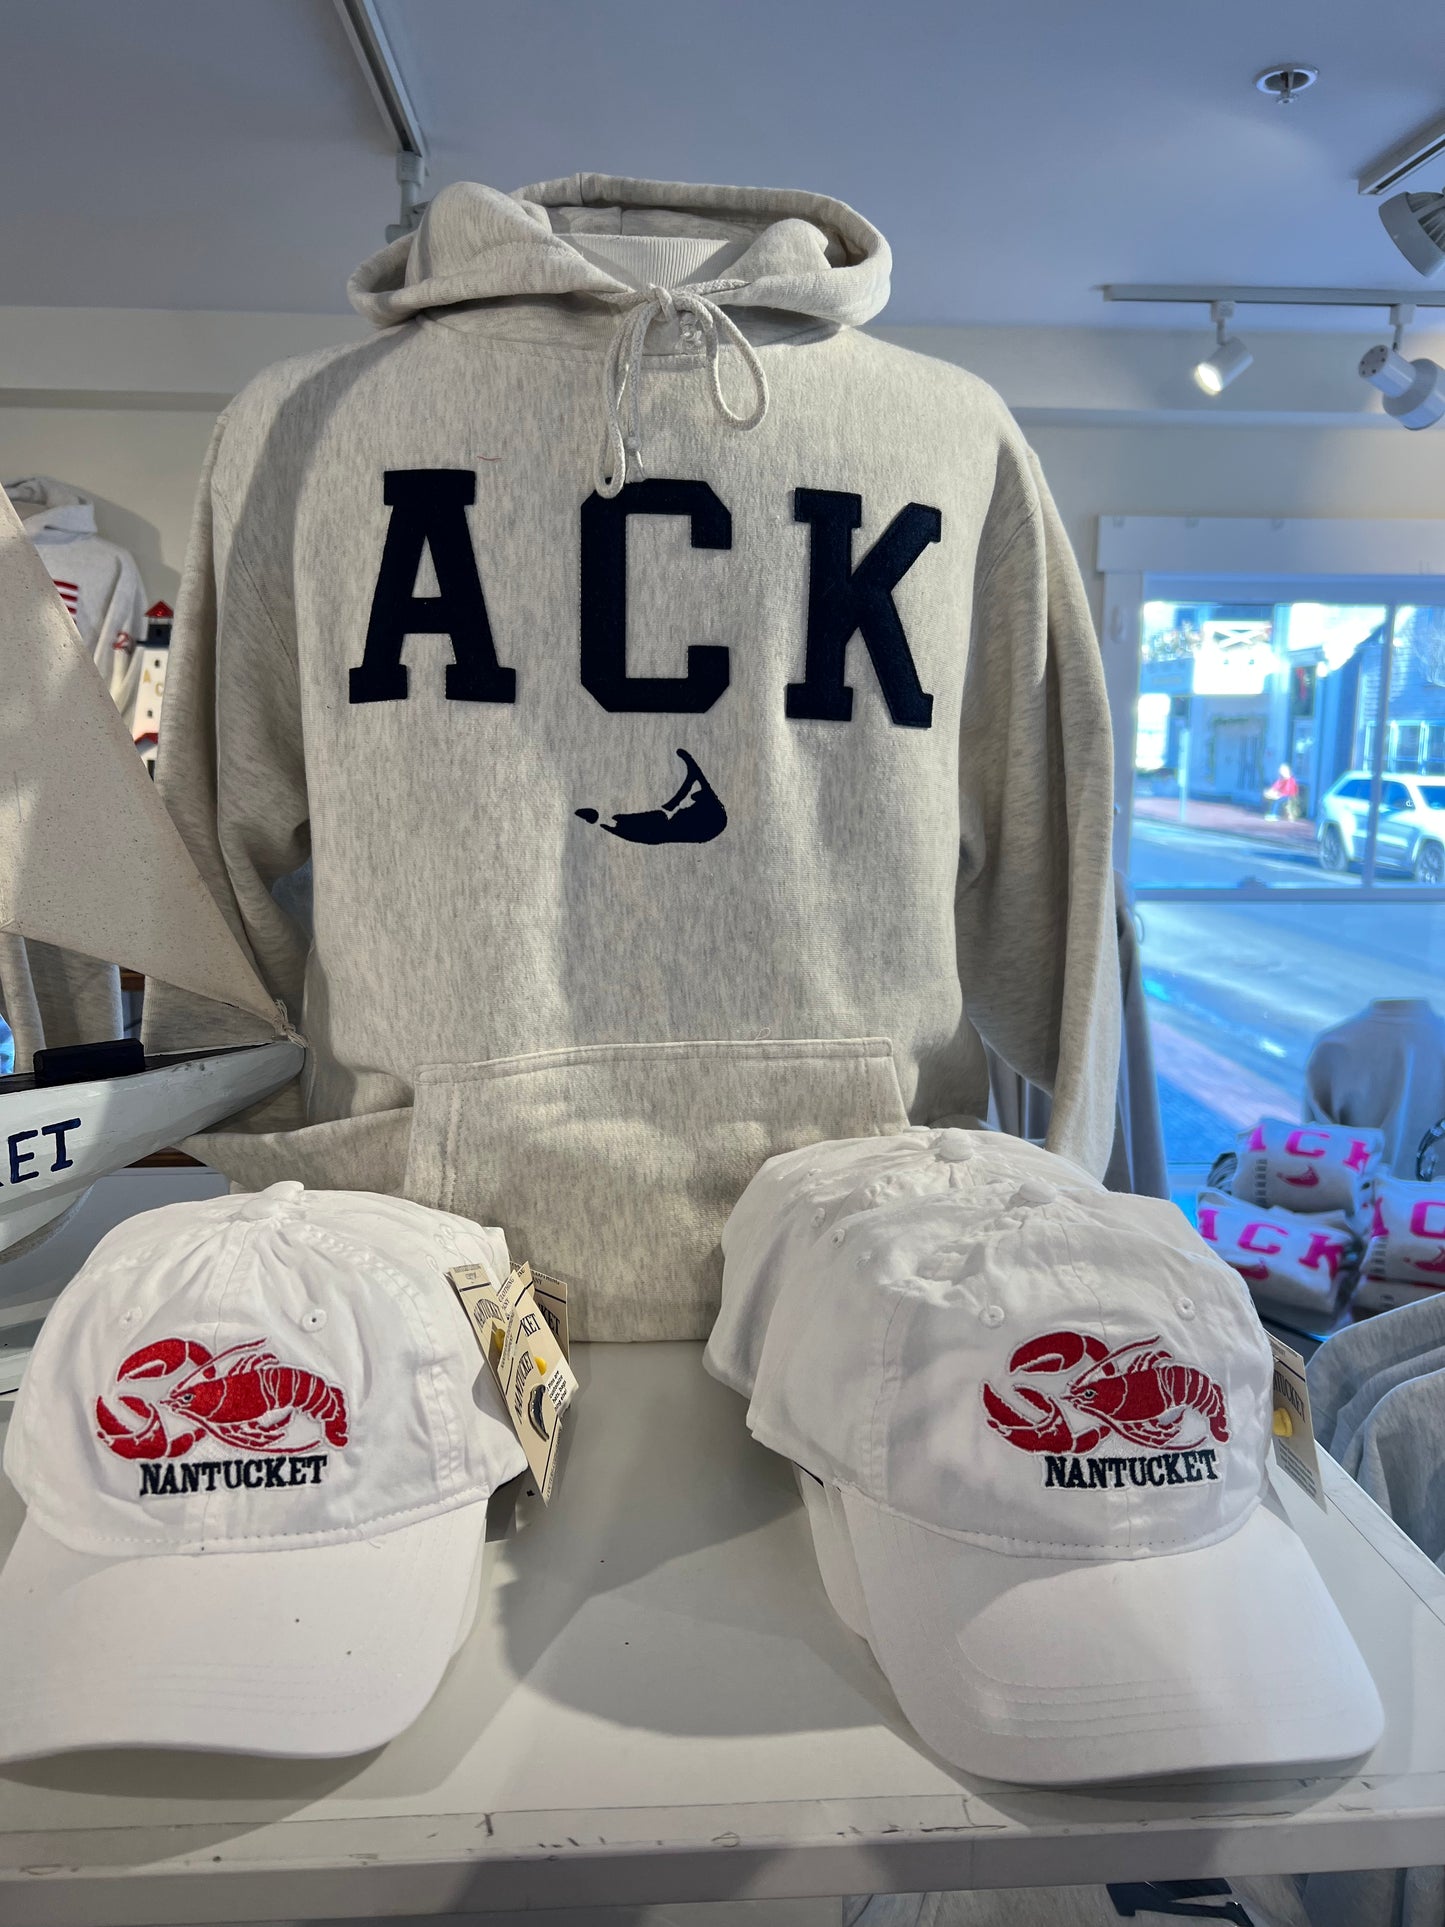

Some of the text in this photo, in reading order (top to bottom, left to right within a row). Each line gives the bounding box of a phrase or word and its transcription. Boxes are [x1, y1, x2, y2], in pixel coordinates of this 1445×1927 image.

[349, 468, 942, 728] ACK
[0, 1117, 81, 1187] ET
[473, 1298, 505, 1333] NANTUCKET
[515, 1351, 534, 1425] NANTUCKET
[139, 1455, 328, 1496] NANTUCKET
[1044, 1449, 1219, 1489] NANTUCKET
